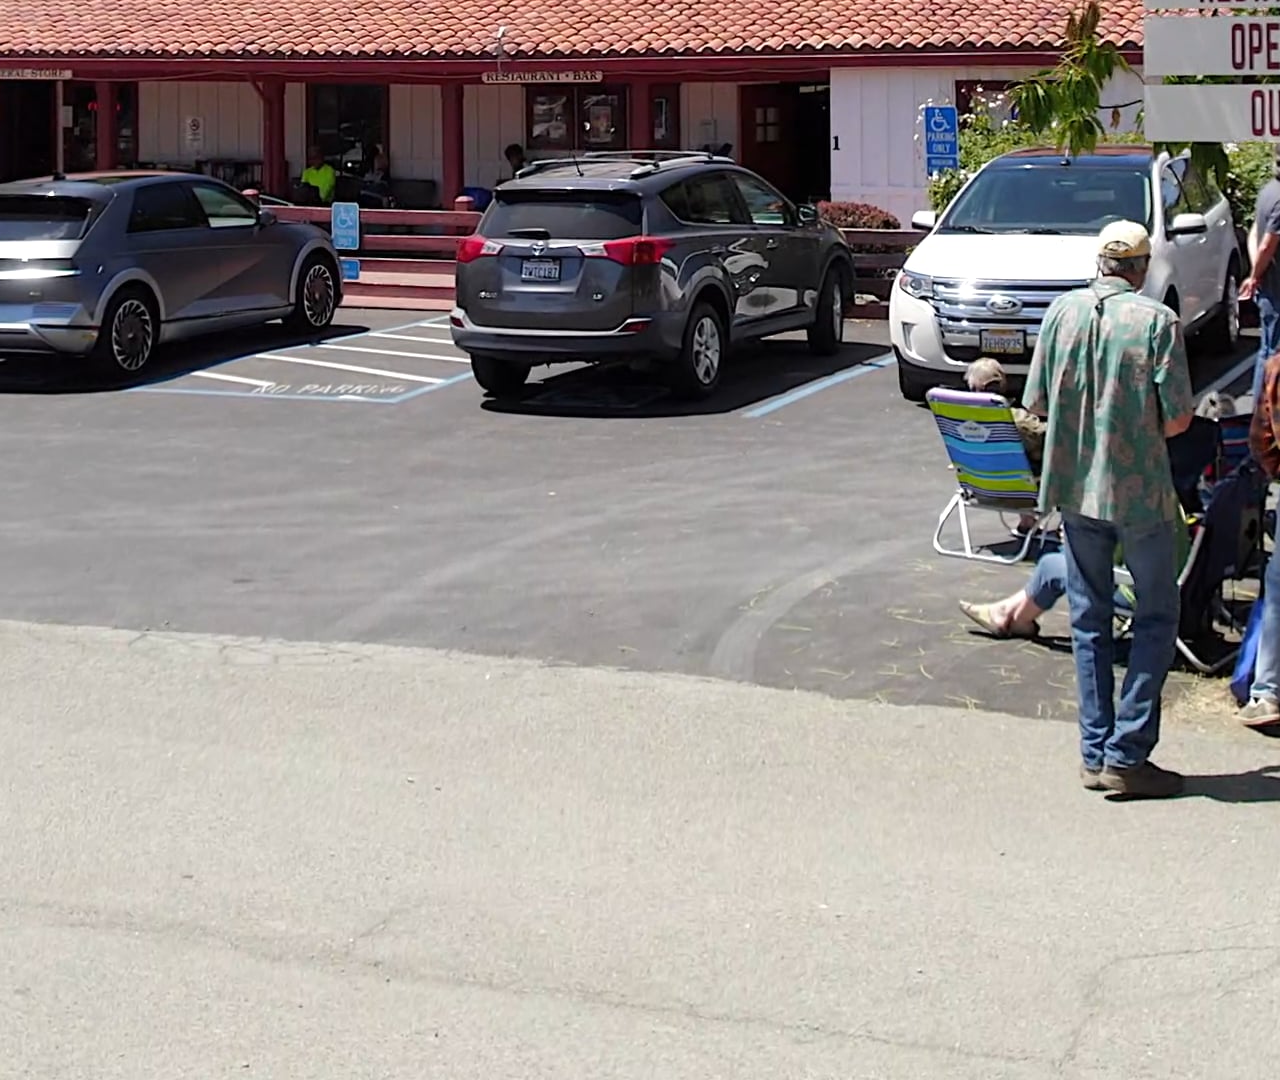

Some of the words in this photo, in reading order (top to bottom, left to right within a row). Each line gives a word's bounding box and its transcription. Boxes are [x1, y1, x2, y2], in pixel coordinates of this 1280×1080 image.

[486, 71, 561, 82] RESTAURANT
[573, 70, 599, 81] BAR
[832, 135, 840, 151] 1
[297, 383, 406, 394] PARKING
